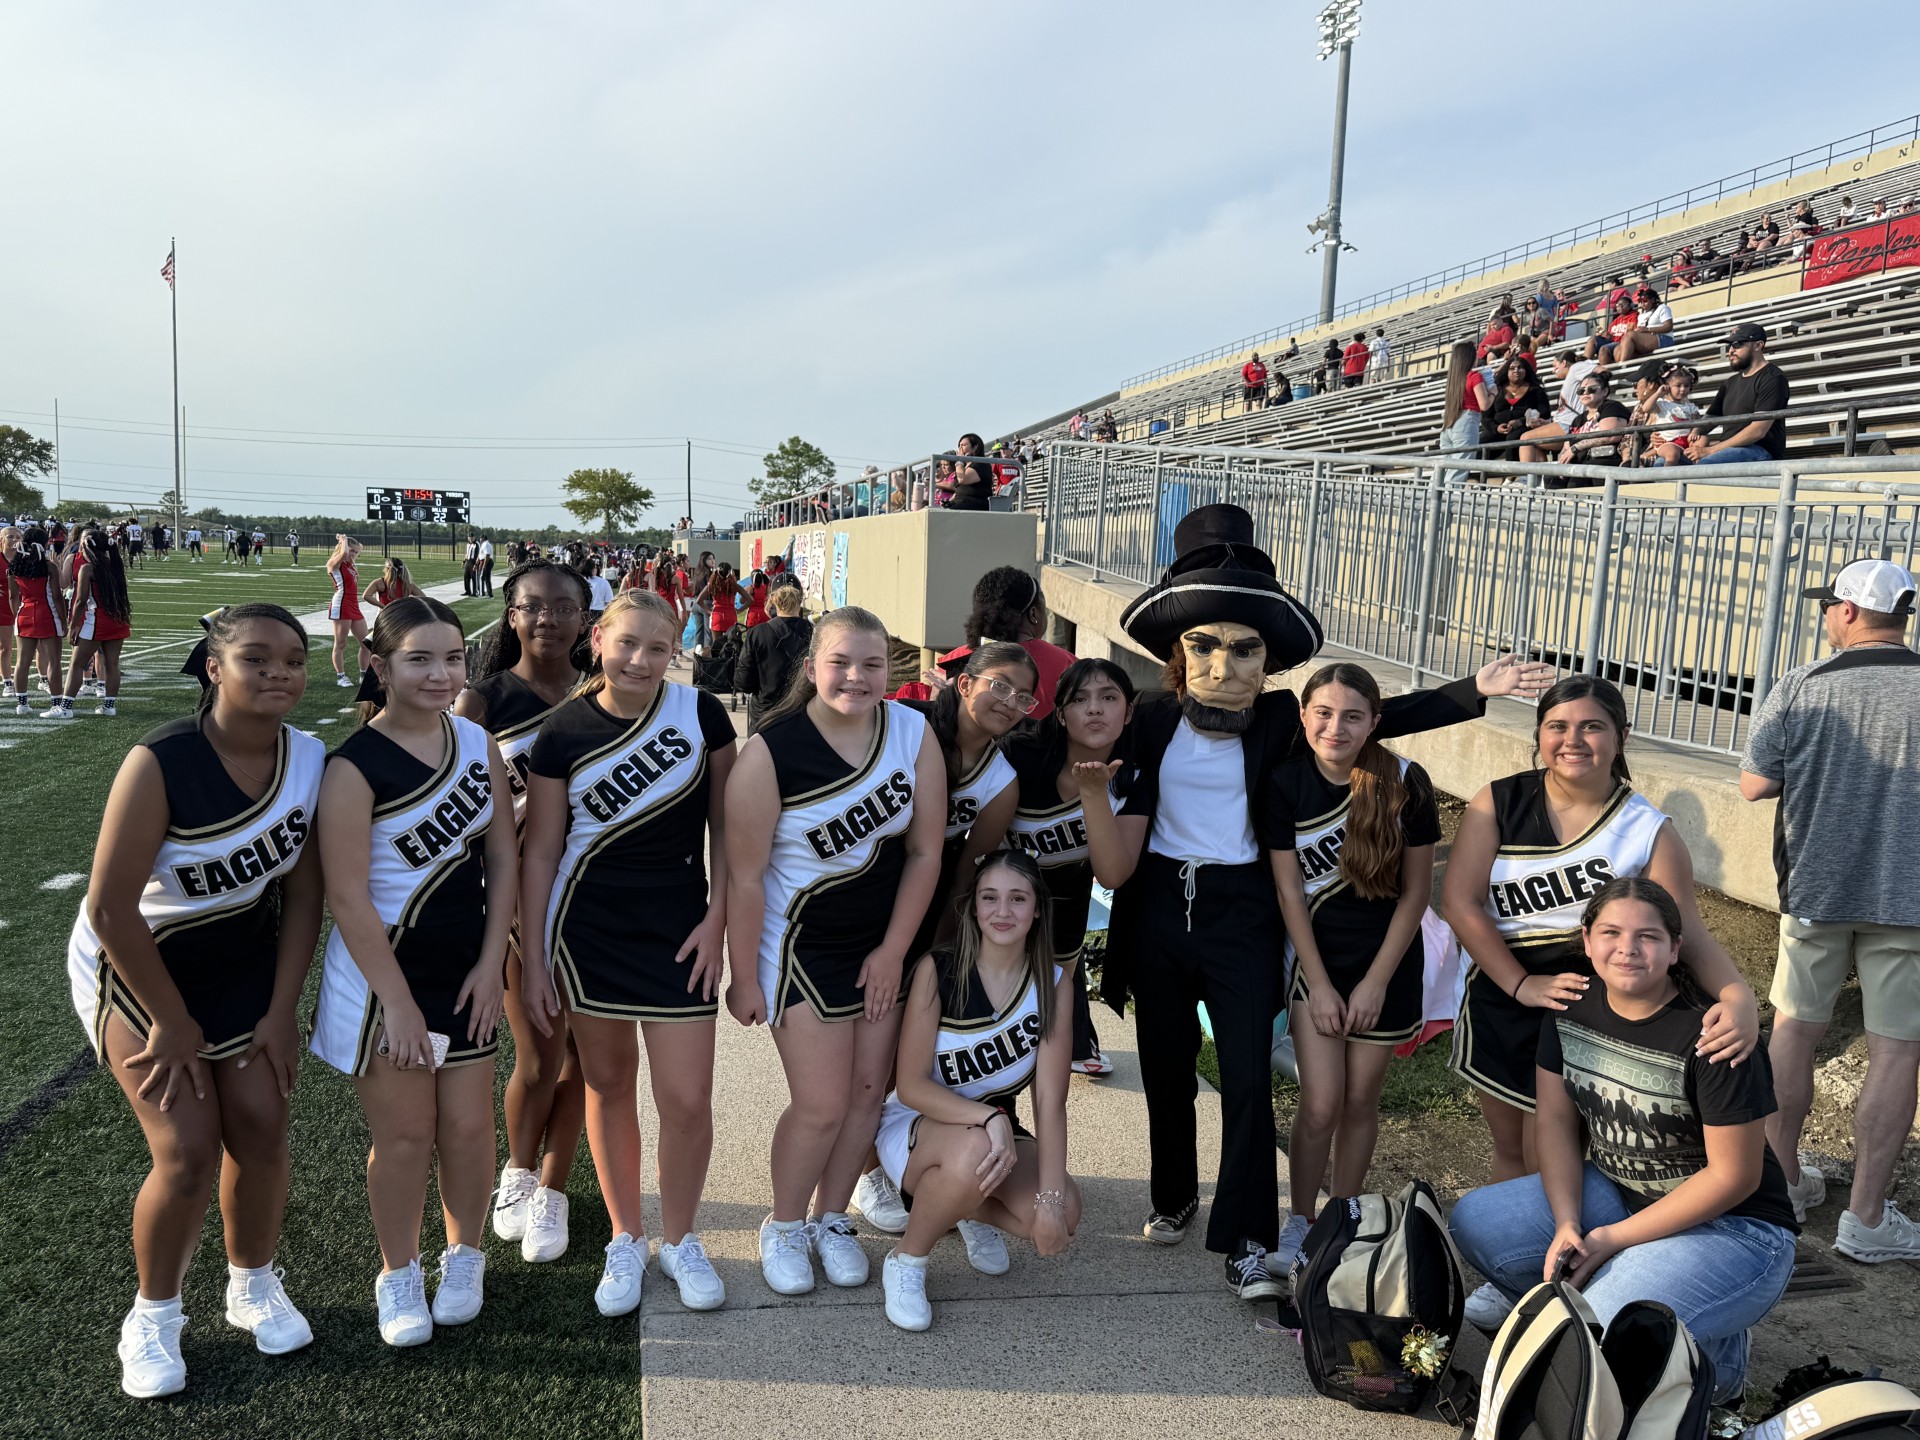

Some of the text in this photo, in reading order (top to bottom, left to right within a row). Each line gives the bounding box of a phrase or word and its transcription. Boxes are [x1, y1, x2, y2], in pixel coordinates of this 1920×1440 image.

[373, 494, 469, 508] 0 3 0 0
[394, 511, 404, 521] 10
[433, 513, 447, 522] 22
[462, 514, 469, 523] 4
[131, 530, 141, 538] 13
[580, 726, 694, 823] EAGLES
[391, 760, 492, 869] EAGLES
[804, 770, 914, 860] EAGLES
[1009, 818, 1087, 857] EAGLE
[172, 807, 309, 898] EAGLES
[1490, 856, 1616, 918] EAGLES
[938, 1012, 1040, 1086] EAGLES
[1640, 1072, 1683, 1095] BOYS
[1742, 1402, 1822, 1440] EAGLES
